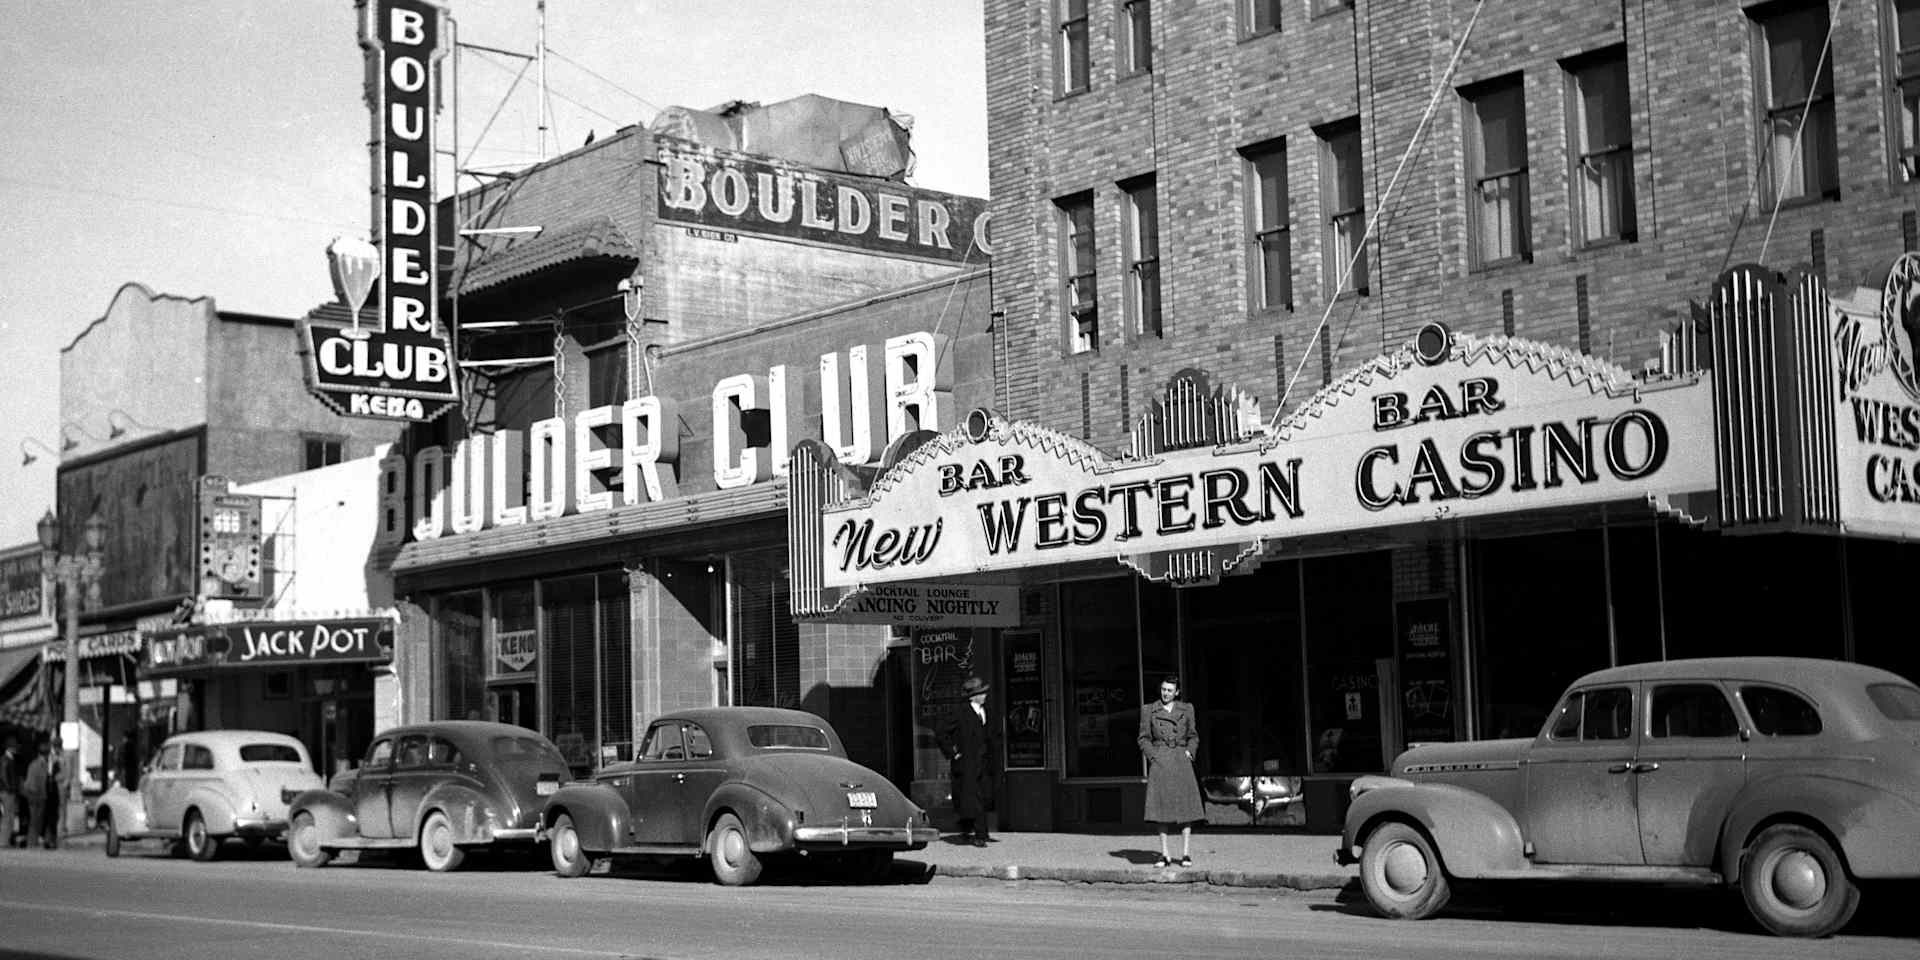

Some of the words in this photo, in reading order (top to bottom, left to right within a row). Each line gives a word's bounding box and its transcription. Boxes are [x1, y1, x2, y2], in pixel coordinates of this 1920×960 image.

[391, 8, 430, 333] BOULDER
[659, 151, 952, 249] BOULDER
[319, 337, 447, 383] CLUB
[350, 393, 424, 419] KENO
[1372, 377, 1506, 431] BAR
[378, 395, 665, 543] BOULDER
[713, 332, 937, 489] CLUB
[938, 453, 1032, 496] BAR
[1356, 409, 1669, 511] CASINO
[833, 516, 942, 571] New
[976, 458, 1304, 555] WESTERN
[853, 598, 916, 613] ANCING
[927, 599, 1000, 615] NIGHTLY
[871, 587, 919, 598] OCKTAIL
[927, 588, 970, 599] LOUNGE
[240, 625, 304, 662] JACK
[310, 627, 369, 658] POT
[914, 645, 960, 664] BAR
[920, 632, 958, 644] COCKTAIL
